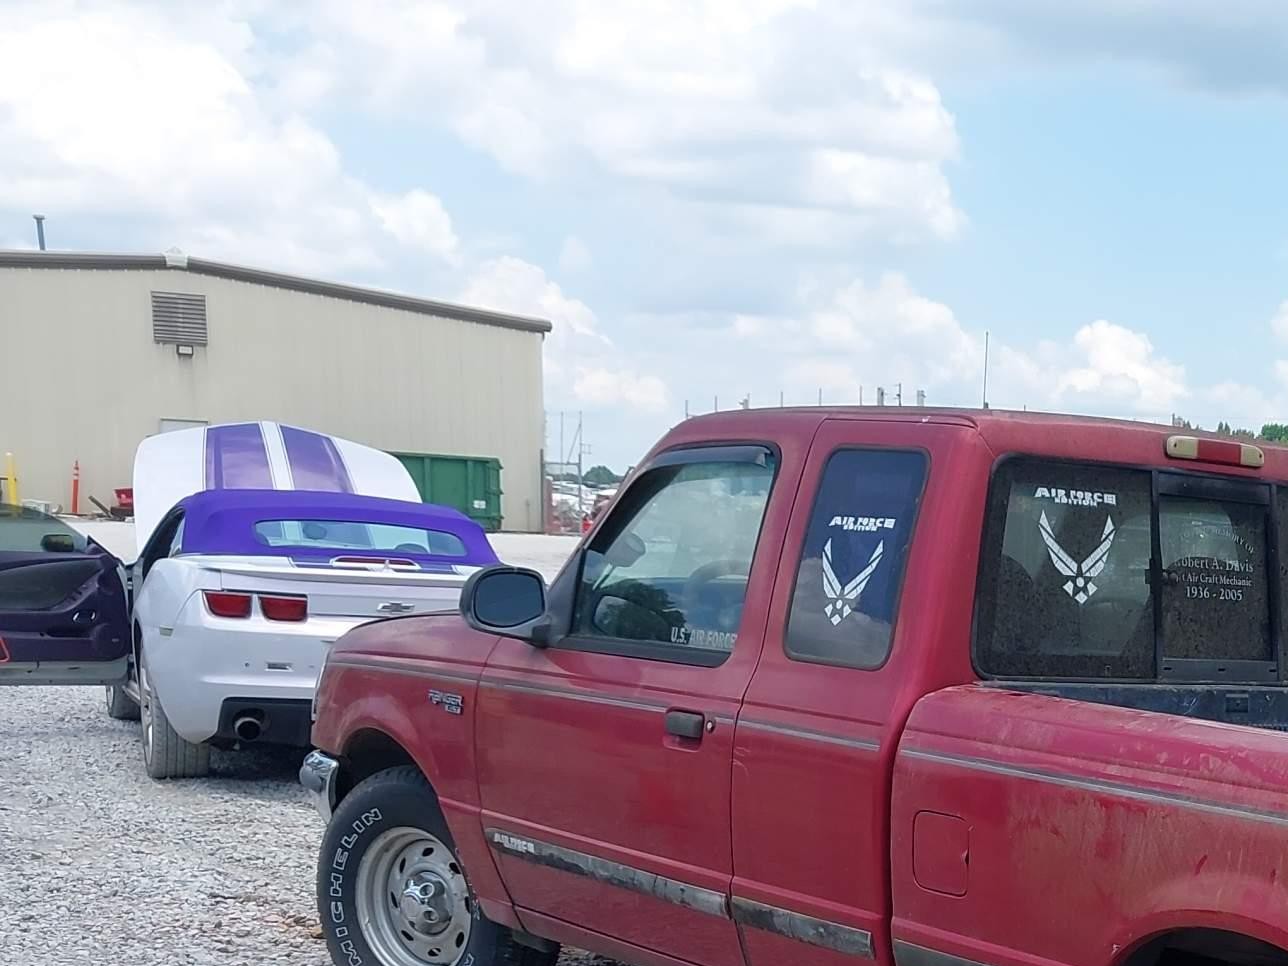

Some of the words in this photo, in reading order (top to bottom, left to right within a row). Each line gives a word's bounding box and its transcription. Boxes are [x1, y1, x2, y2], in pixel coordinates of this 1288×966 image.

[1034, 487, 1066, 498] AIR
[1069, 490, 1117, 505] FORCE
[828, 516, 856, 527] AIR
[856, 517, 896, 529] FORCE
[1212, 557, 1224, 571] A.
[1225, 558, 1254, 574] Davis
[1199, 573, 1218, 585] Craft
[1219, 575, 1253, 588] Mechanic
[1185, 586, 1210, 599] 1936
[1219, 588, 1243, 601] 2005
[671, 626, 688, 644] U.S.
[688, 629, 705, 646] AIR
[705, 631, 739, 650] FORCE
